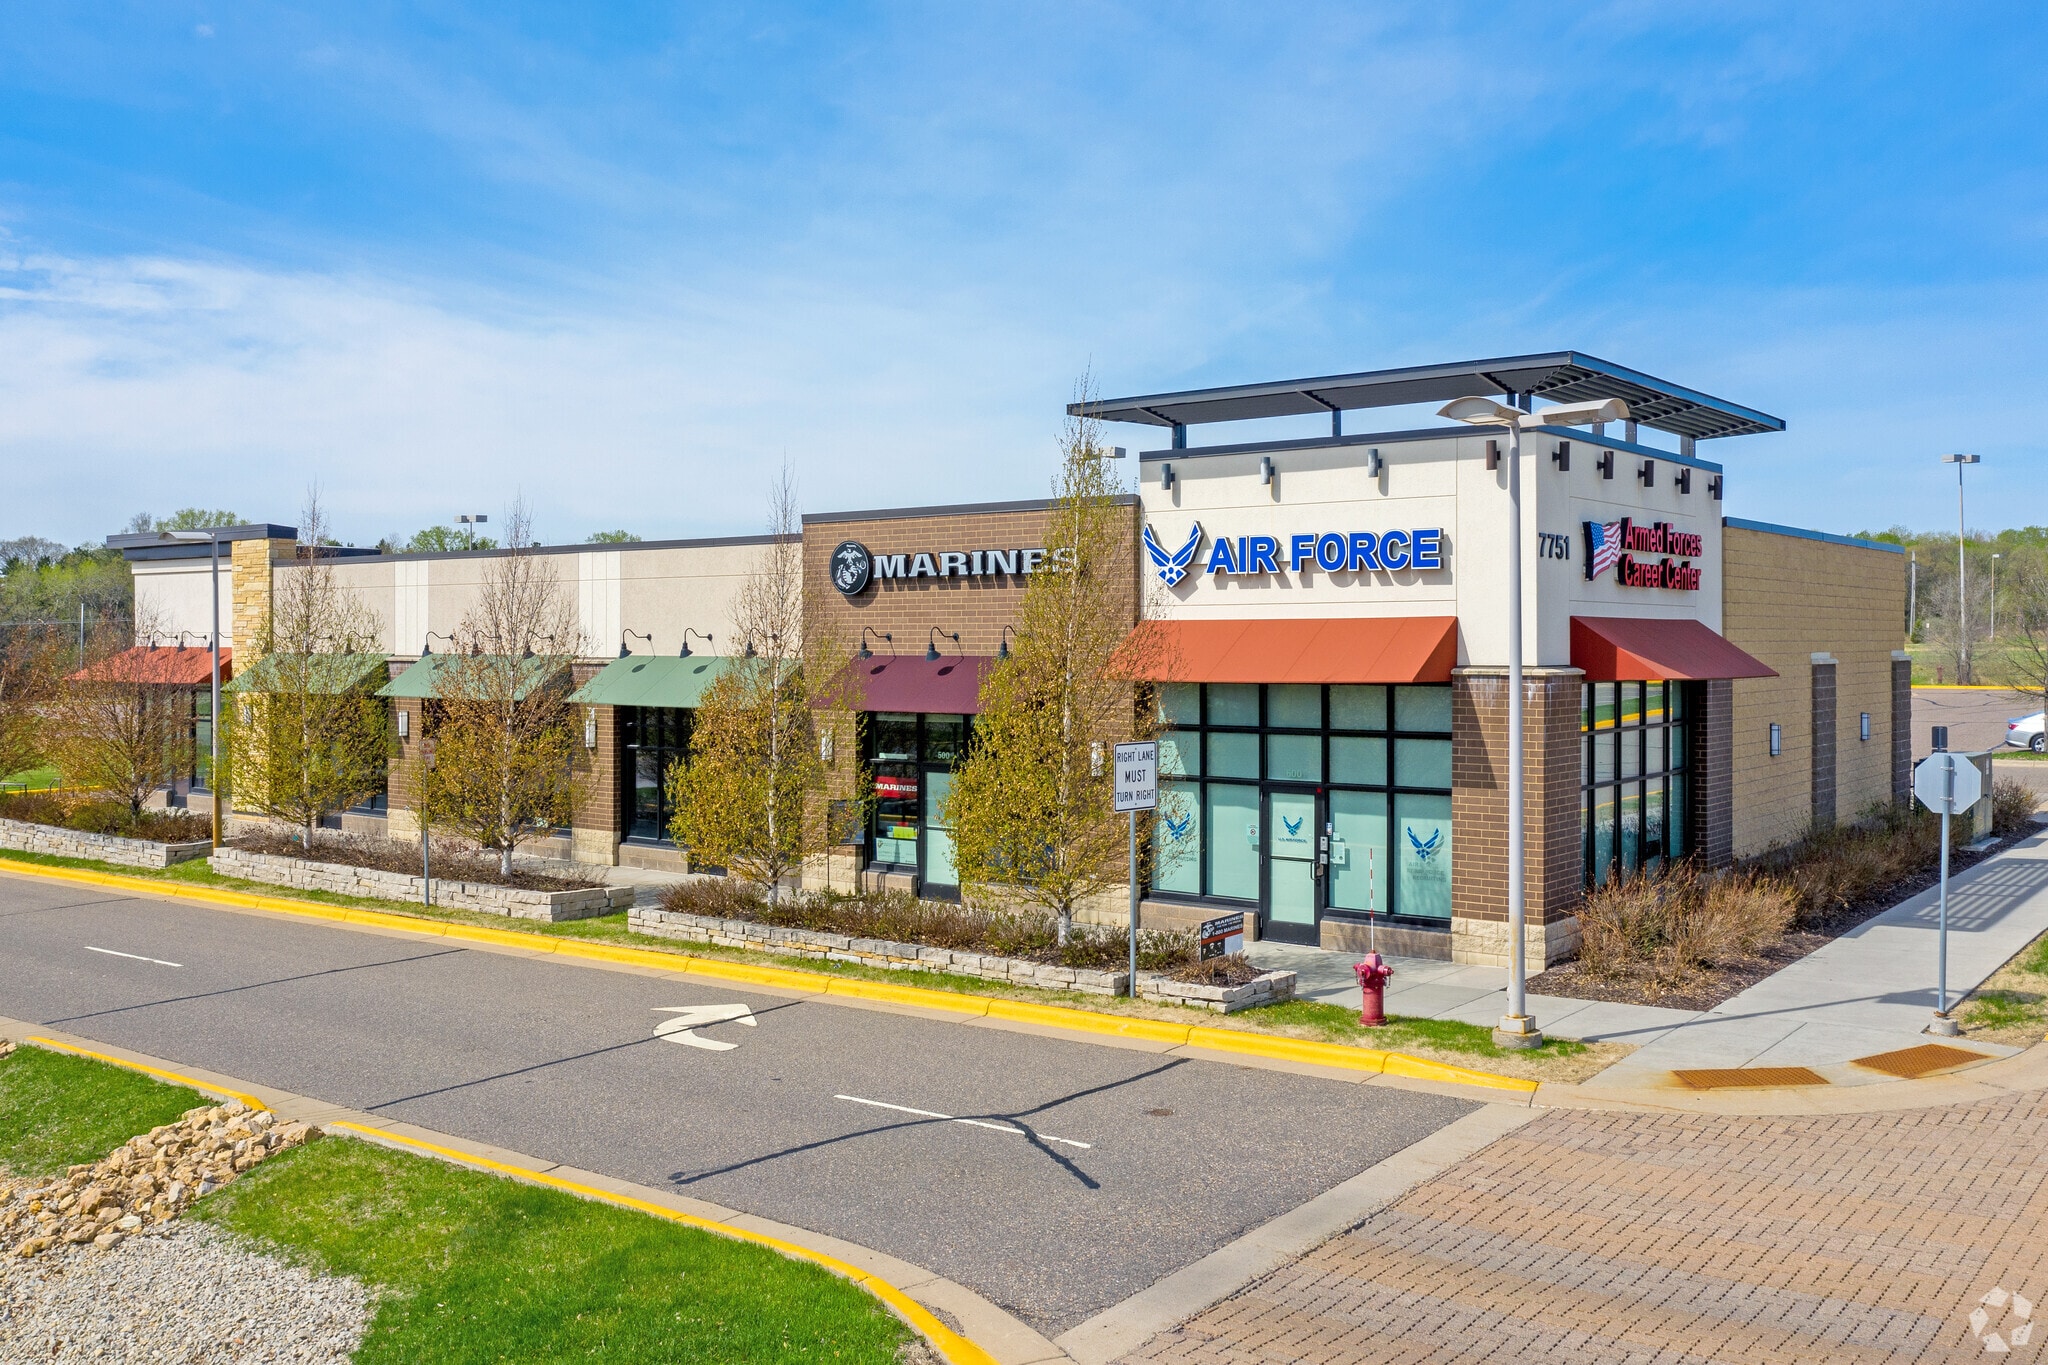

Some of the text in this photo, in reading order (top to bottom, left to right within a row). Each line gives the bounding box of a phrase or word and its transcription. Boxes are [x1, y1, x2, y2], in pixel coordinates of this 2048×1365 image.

[1624, 517, 1702, 557] Armed Forces
[1205, 528, 1442, 575] AIR FORCE
[1538, 532, 1570, 560] 7751
[1624, 553, 1702, 590] Career Center
[937, 751, 950, 760] 500
[1117, 750, 1154, 762] RIGHT LANE
[1125, 769, 1146, 783] MUST
[875, 782, 918, 792] MARINES
[1117, 789, 1154, 802] TURN RIGHT
